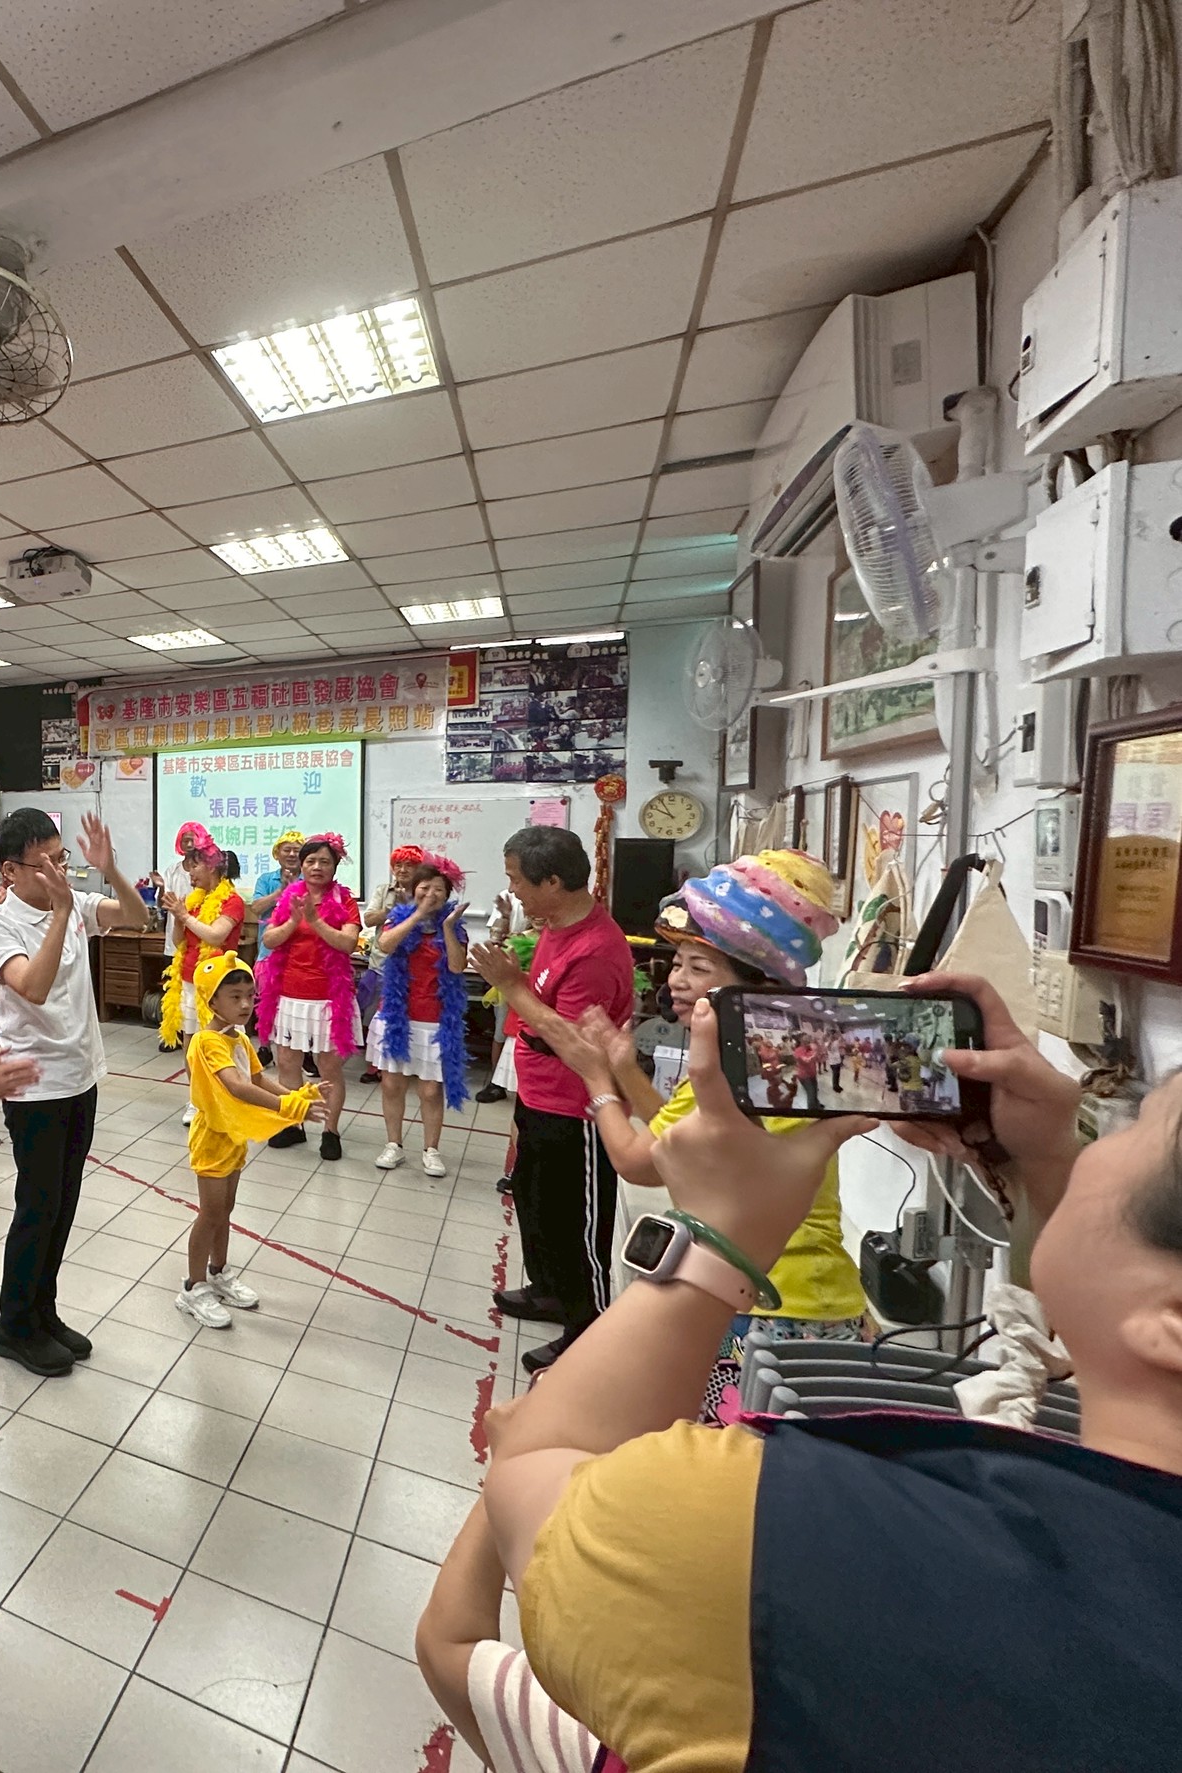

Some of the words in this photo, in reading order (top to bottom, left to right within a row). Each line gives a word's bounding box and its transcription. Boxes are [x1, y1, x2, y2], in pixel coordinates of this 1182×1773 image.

[122, 673, 399, 721] 基隆市安樂區五福社區發展協會
[95, 703, 435, 751] 社區照顧關懷據點暨C級巷弄長照站
[162, 749, 354, 775] 基隆市安樂區五福社區發展協會
[189, 775, 207, 798] 歡
[303, 771, 321, 795] 迎
